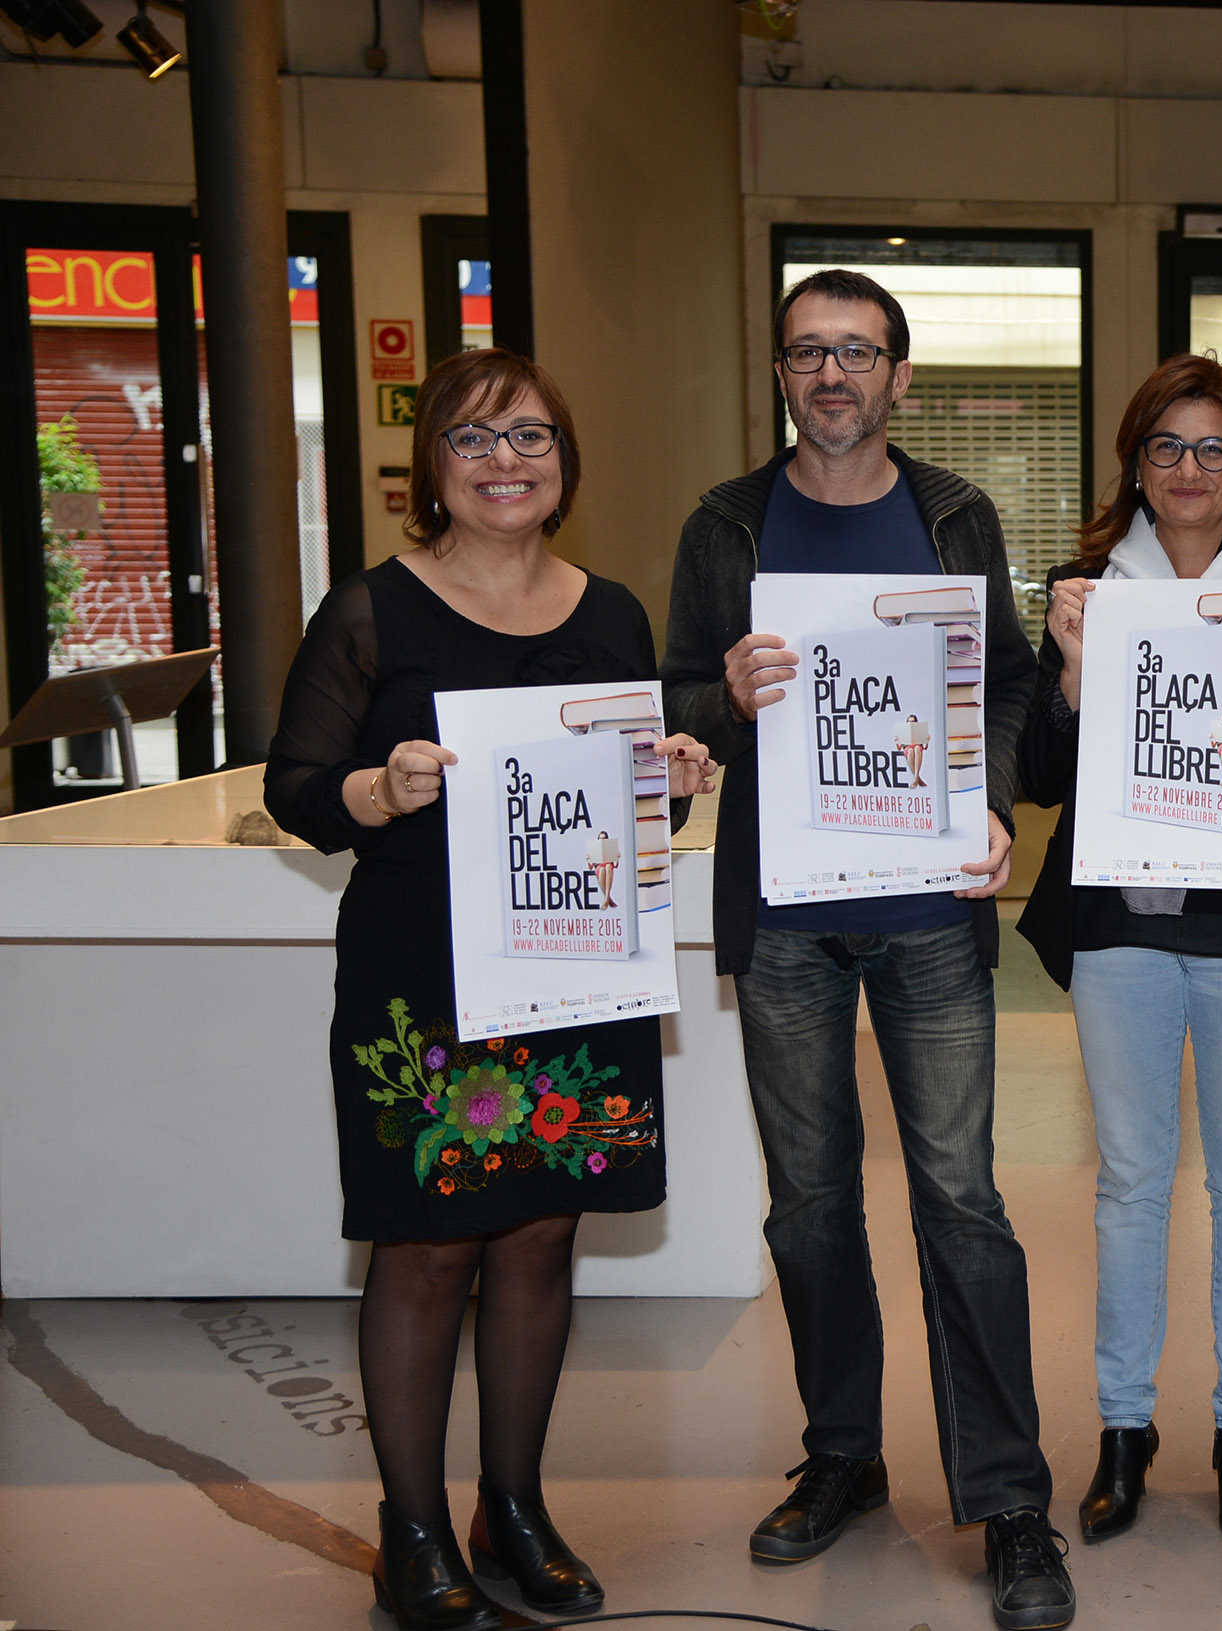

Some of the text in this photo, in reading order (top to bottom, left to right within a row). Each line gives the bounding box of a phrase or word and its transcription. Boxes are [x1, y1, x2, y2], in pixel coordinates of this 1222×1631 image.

[813, 644, 841, 679] 3a
[1137, 640, 1163, 674] 3a
[814, 675, 901, 716] PLAÇA
[1136, 673, 1218, 713] PLAÇA
[816, 714, 865, 750] DEL
[1135, 709, 1181, 745] DEL
[505, 757, 533, 795] 3a
[818, 750, 910, 788] LLIBRE
[1134, 743, 1221, 786] LLIBRE
[508, 789, 592, 834] PLAÇA
[820, 793, 932, 814] 19-22 NOVEMBRE 2015
[1132, 783, 1159, 802] 19-22
[1163, 787, 1212, 809] NOVEMBRE
[509, 833, 557, 872] DEL
[511, 871, 600, 911] LLIBRE
[512, 918, 622, 936] 19-22 NOVEMBRE 2015
